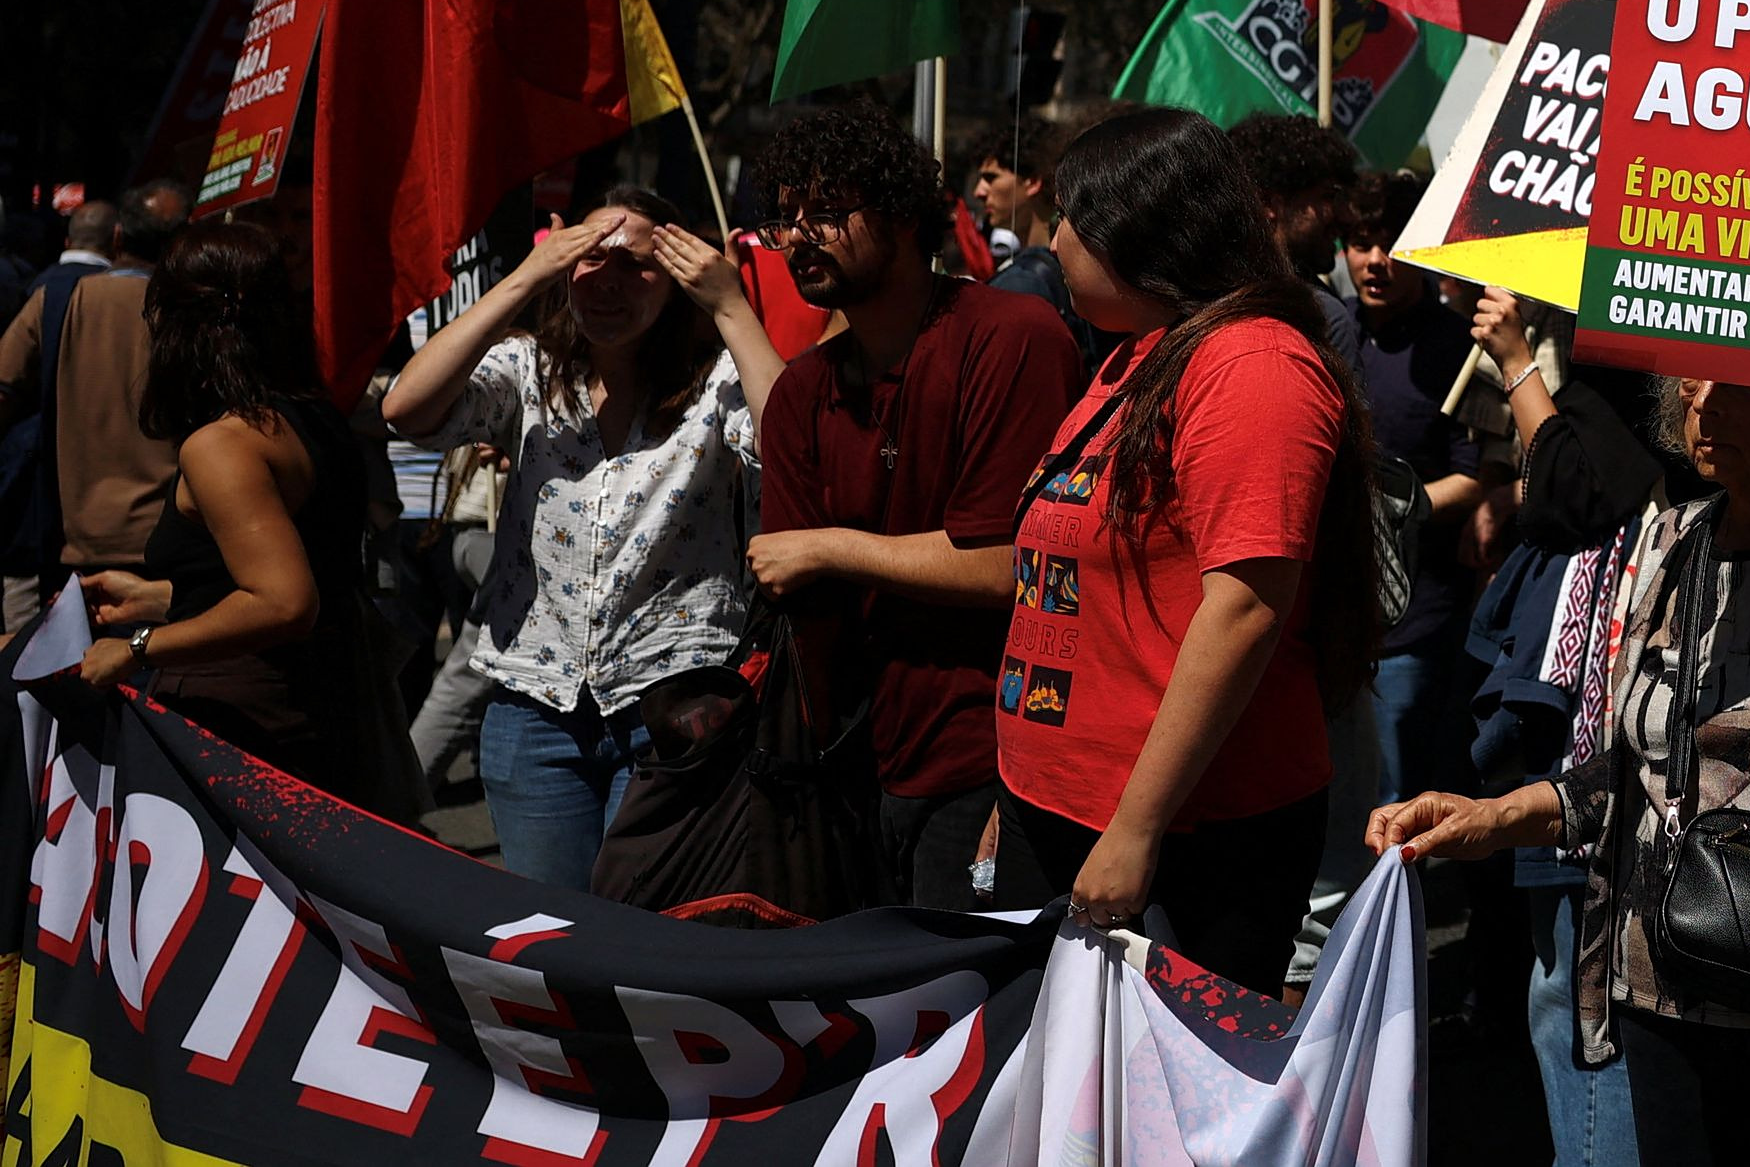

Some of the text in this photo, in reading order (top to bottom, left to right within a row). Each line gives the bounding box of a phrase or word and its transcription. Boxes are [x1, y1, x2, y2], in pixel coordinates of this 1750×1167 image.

[1520, 41, 1611, 99] PAC
[1522, 94, 1599, 152] VAI
[1625, 157, 1646, 196] É
[1619, 205, 1705, 254] UMA
[1608, 295, 1748, 339] GARANTIR
[1011, 614, 1079, 659] OURS
